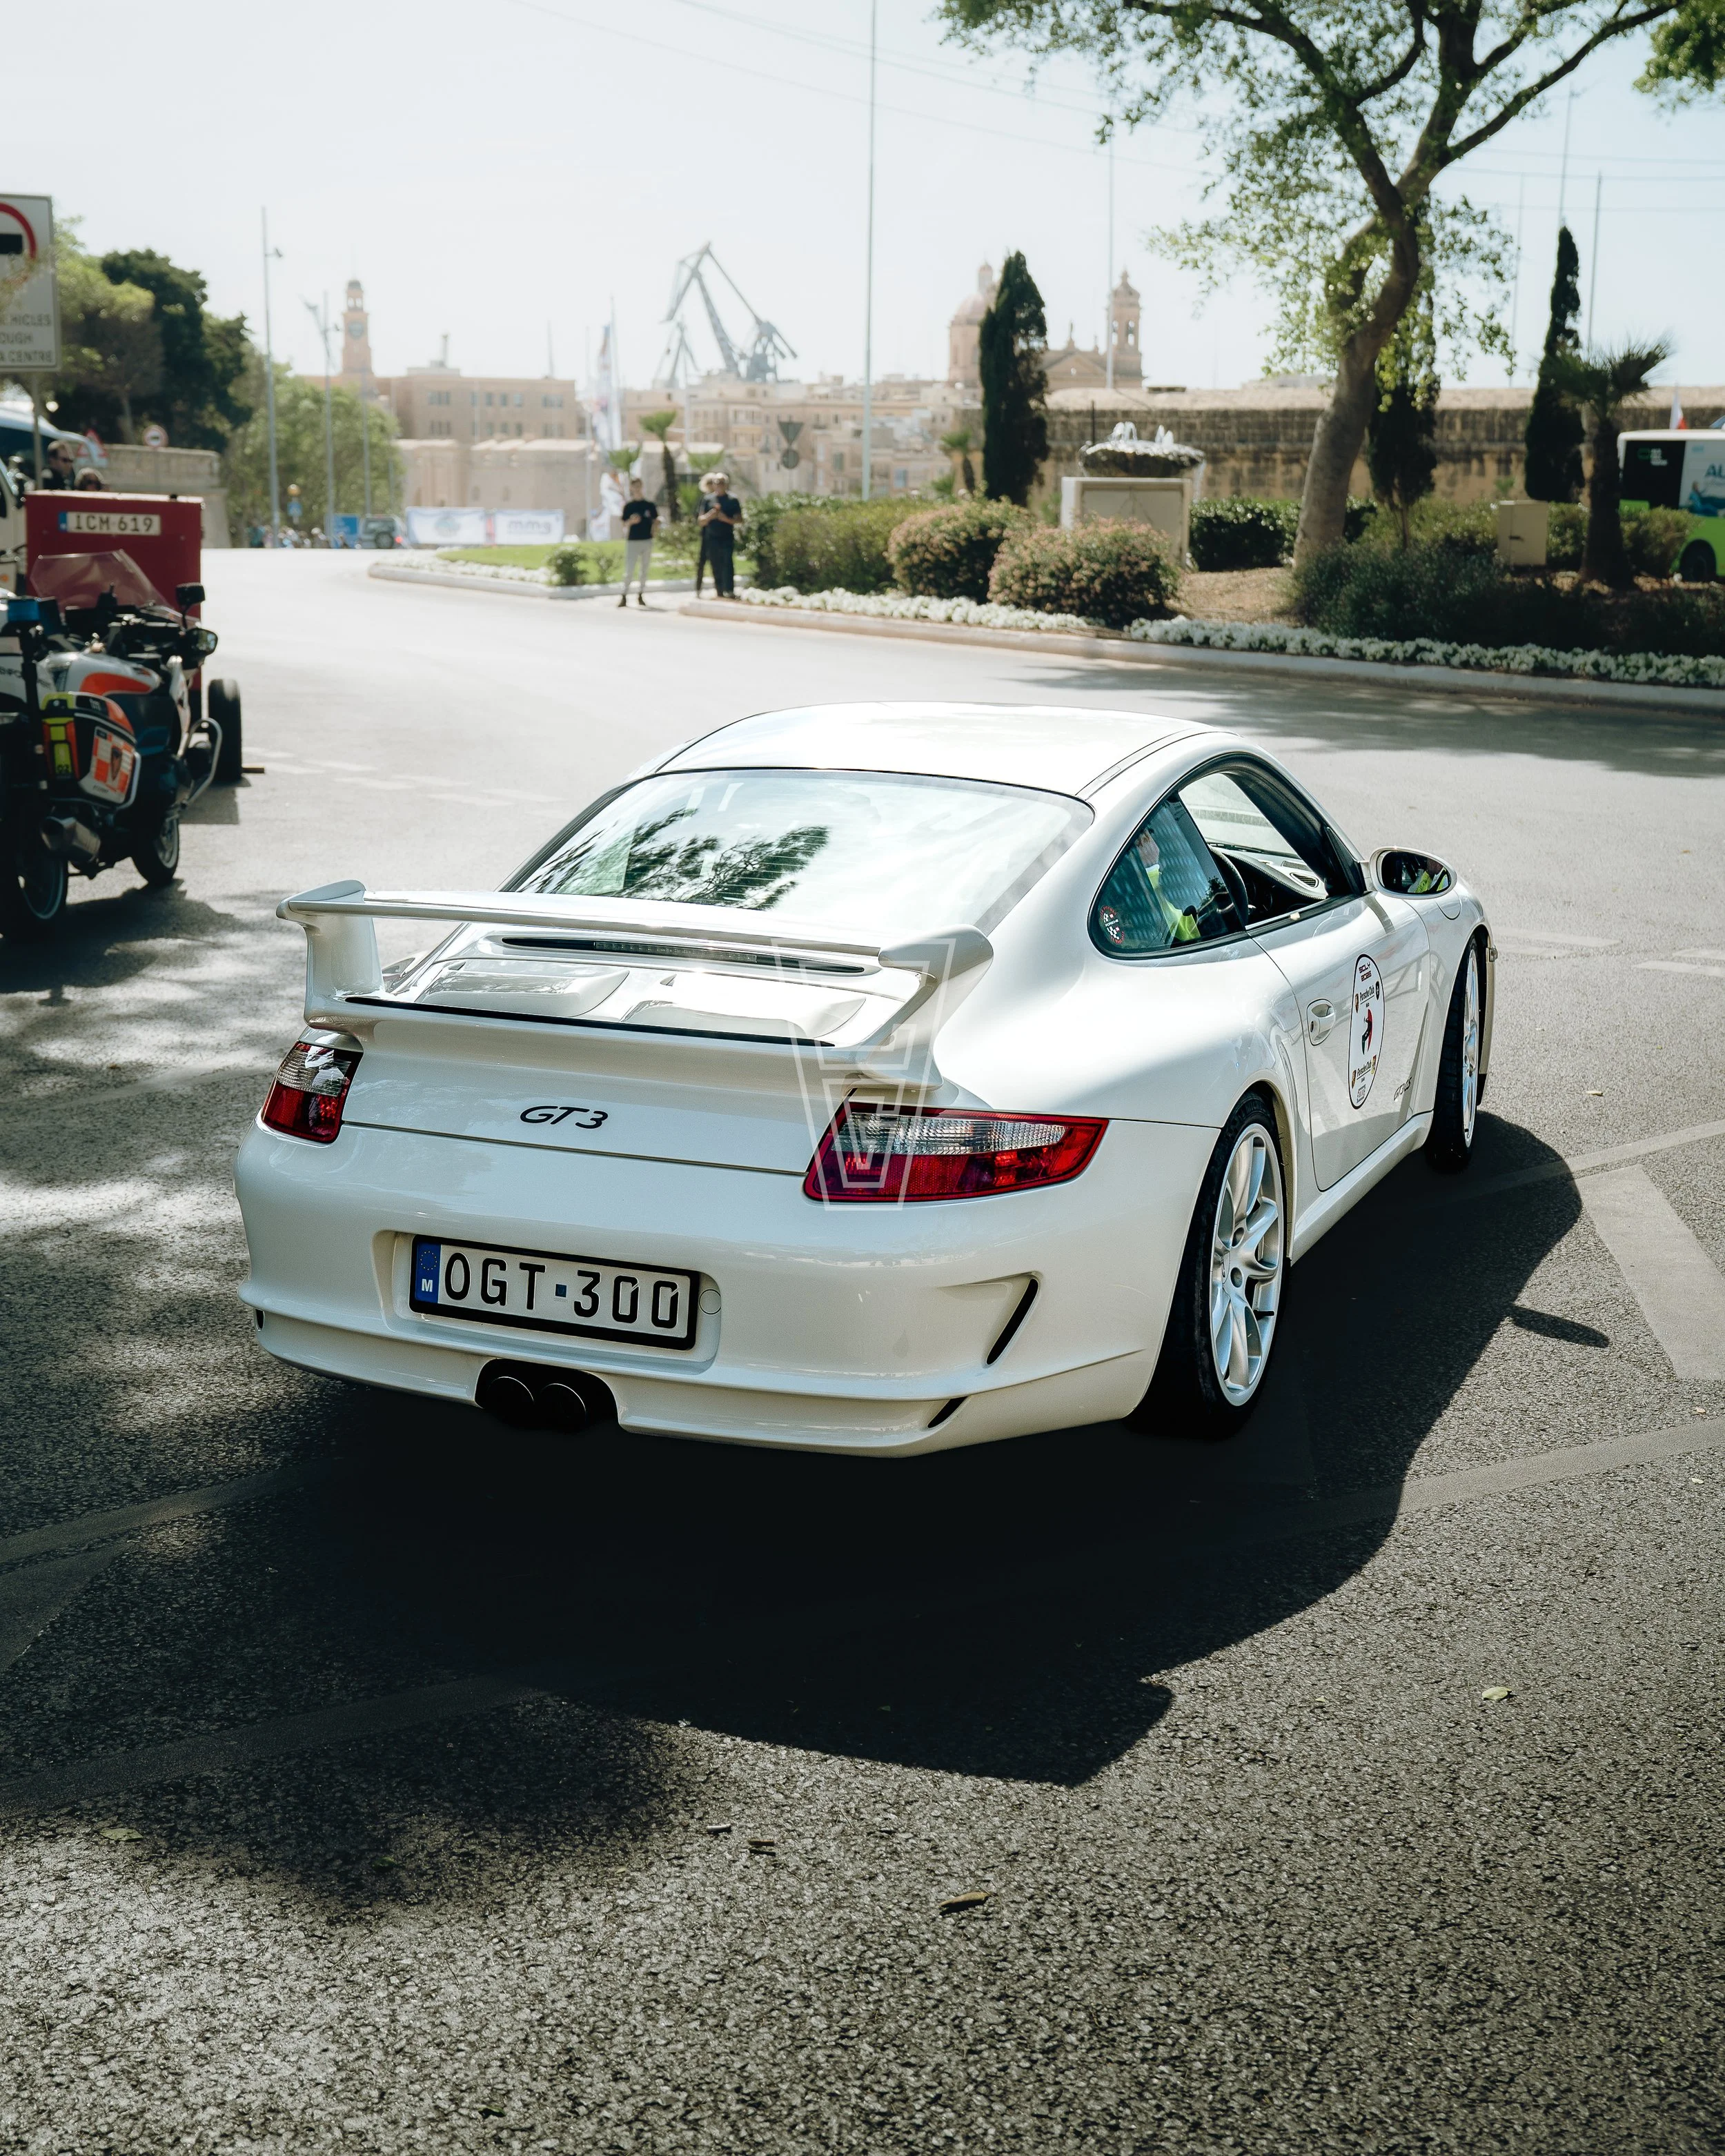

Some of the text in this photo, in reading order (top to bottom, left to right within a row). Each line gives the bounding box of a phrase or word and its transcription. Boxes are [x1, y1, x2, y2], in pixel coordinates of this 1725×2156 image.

[9, 350, 52, 362] CENTRE
[117, 515, 153, 532] 619
[1359, 989, 1370, 1001] Porsche
[1357, 1064, 1366, 1077] Porsche
[520, 1105, 609, 1129] GT3
[421, 1279, 433, 1292] M
[444, 1252, 680, 1329] OGT 300
